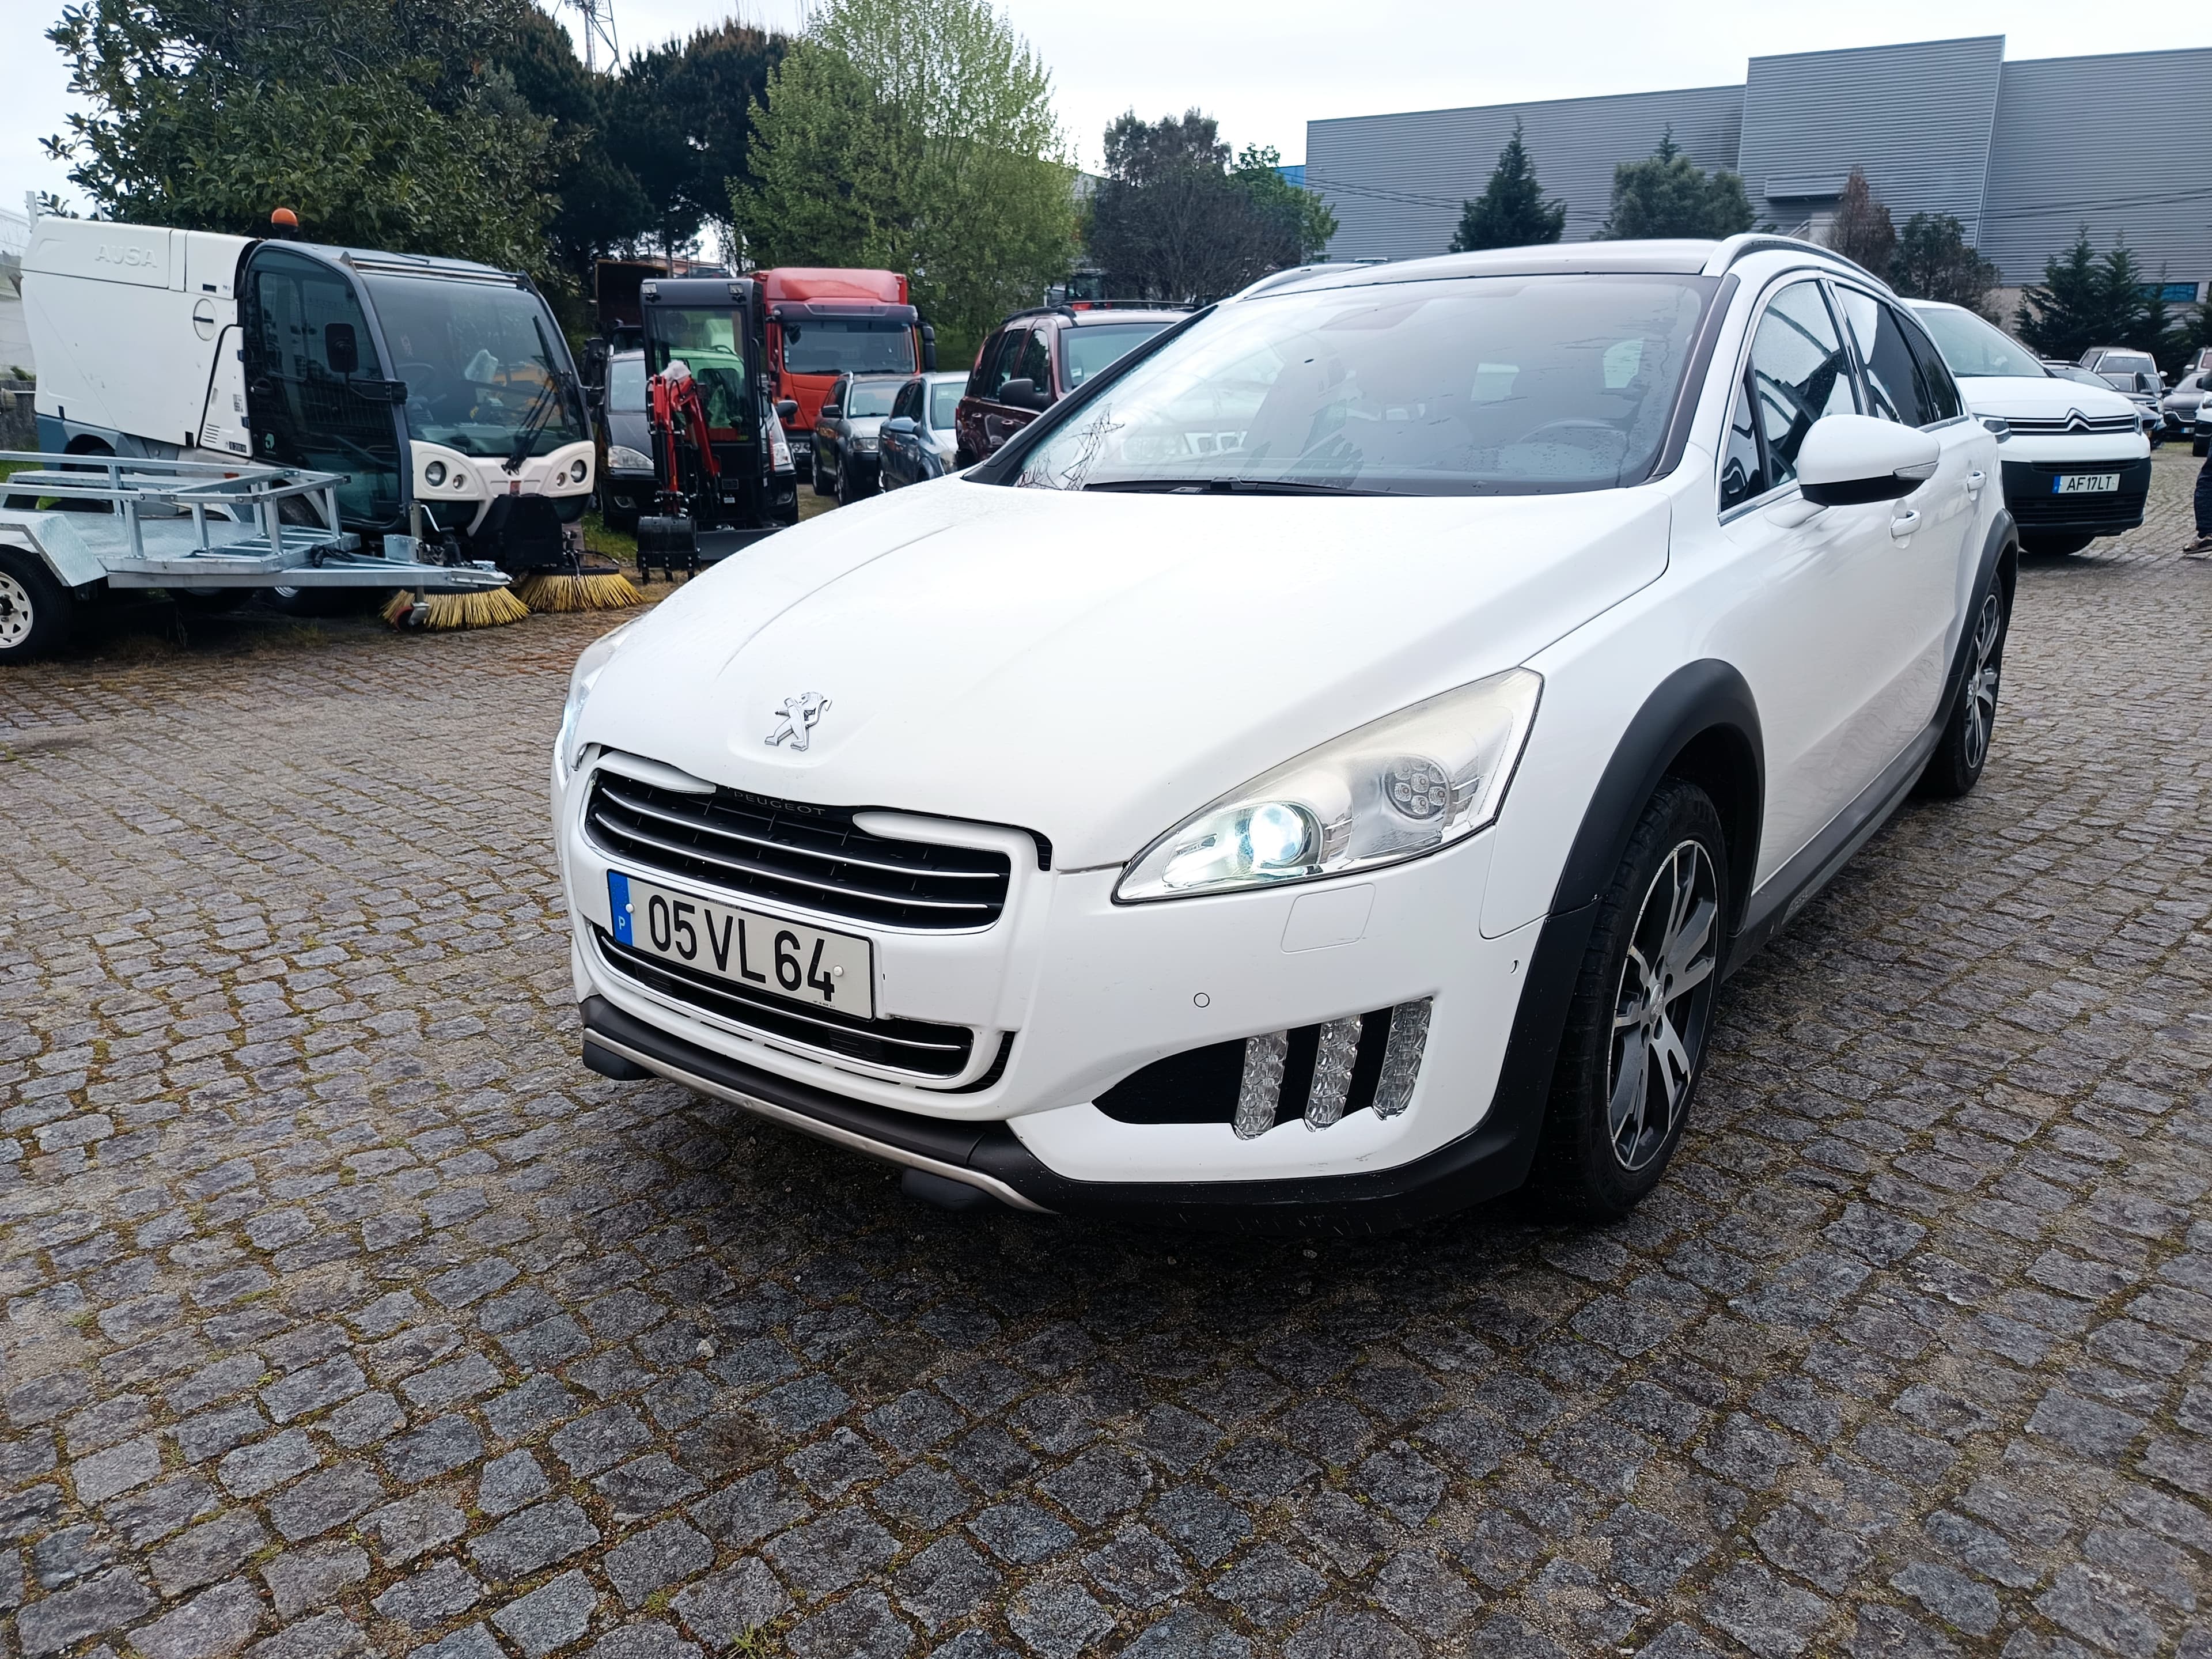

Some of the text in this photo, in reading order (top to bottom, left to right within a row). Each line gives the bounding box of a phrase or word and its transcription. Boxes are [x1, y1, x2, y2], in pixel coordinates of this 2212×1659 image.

[94, 244, 157, 268] AUSA
[734, 791, 825, 815] PEUGEOT
[618, 916, 626, 930] P
